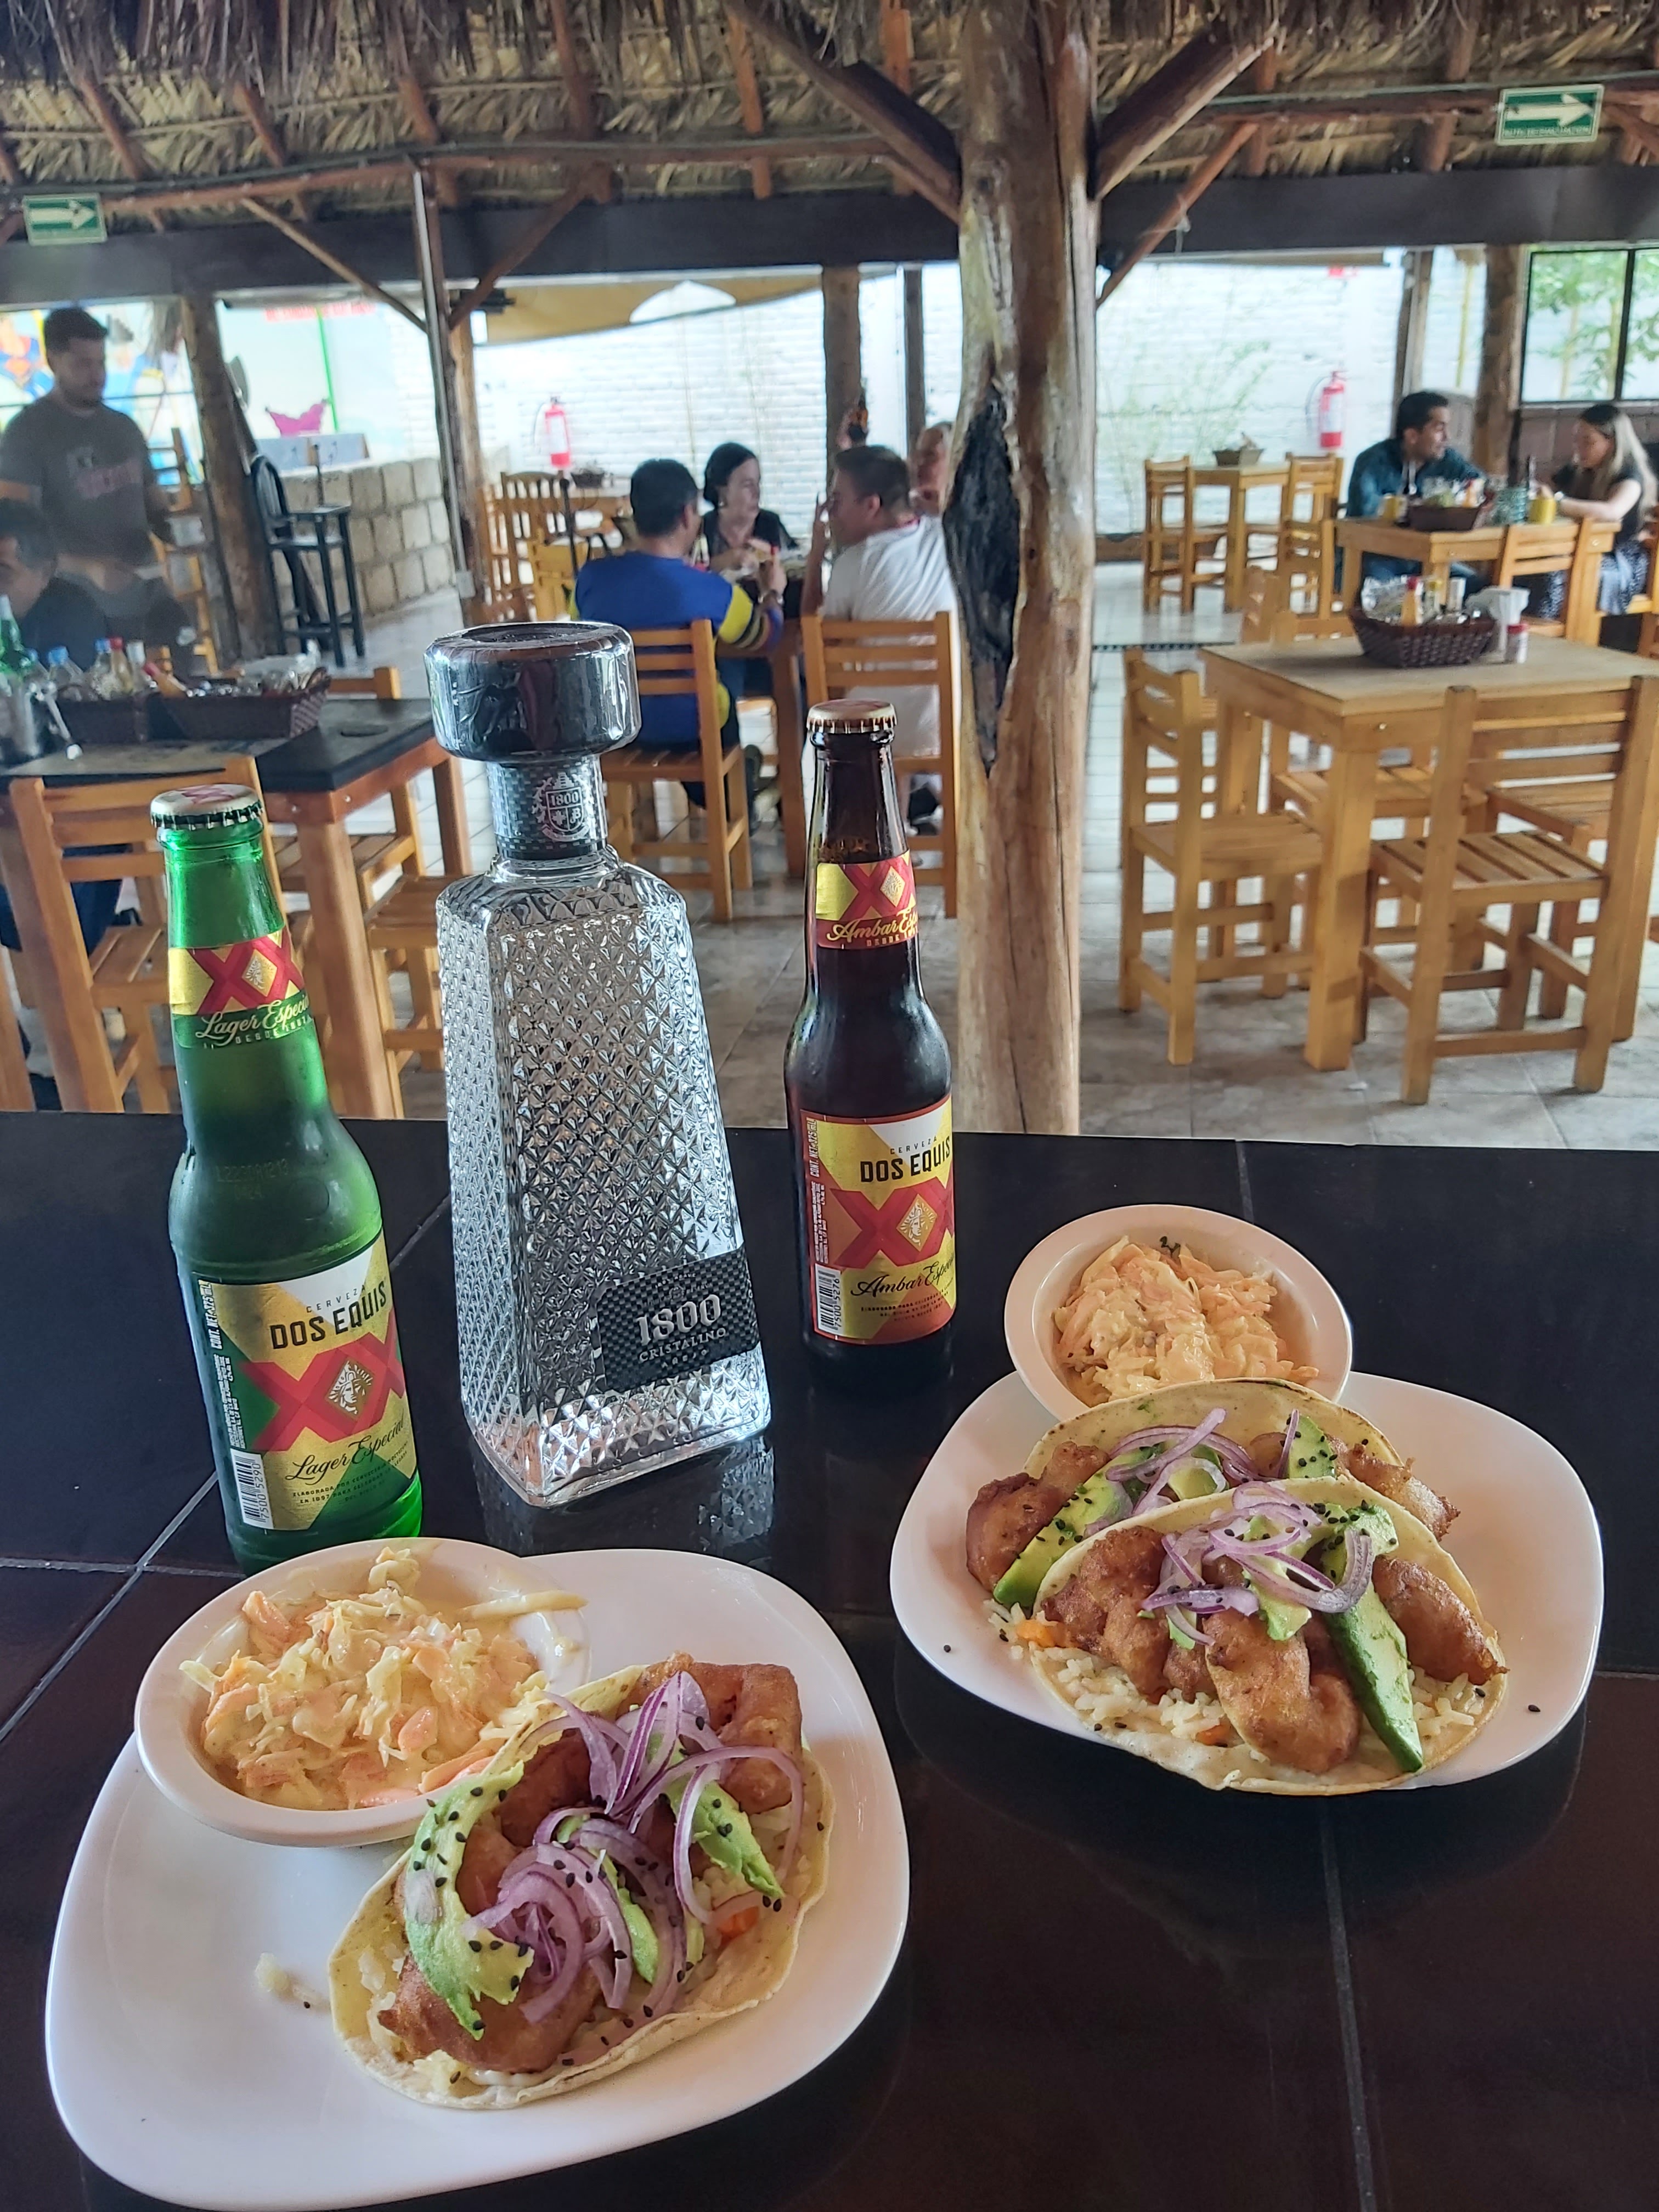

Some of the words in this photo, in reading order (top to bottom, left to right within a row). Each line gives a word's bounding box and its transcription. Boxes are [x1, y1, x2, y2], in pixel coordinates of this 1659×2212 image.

[551, 791, 579, 806] 1800
[826, 918, 900, 943] Ambar
[195, 1011, 261, 1046] Lager
[257, 995, 309, 1030] Especi
[860, 1158, 904, 1182] DOS
[910, 1136, 950, 1176] EQUIS
[890, 1136, 937, 1154] CERVEZA
[306, 1284, 366, 1313] CERVEZA
[850, 1274, 924, 1297] Ambar
[269, 1316, 326, 1350] DOS
[332, 1280, 387, 1335] EQUIS
[636, 1294, 721, 1346] 1800
[639, 1327, 726, 1363] CRISTALINO
[285, 1454, 351, 1486] Lager
[348, 1408, 404, 1464] Especial
